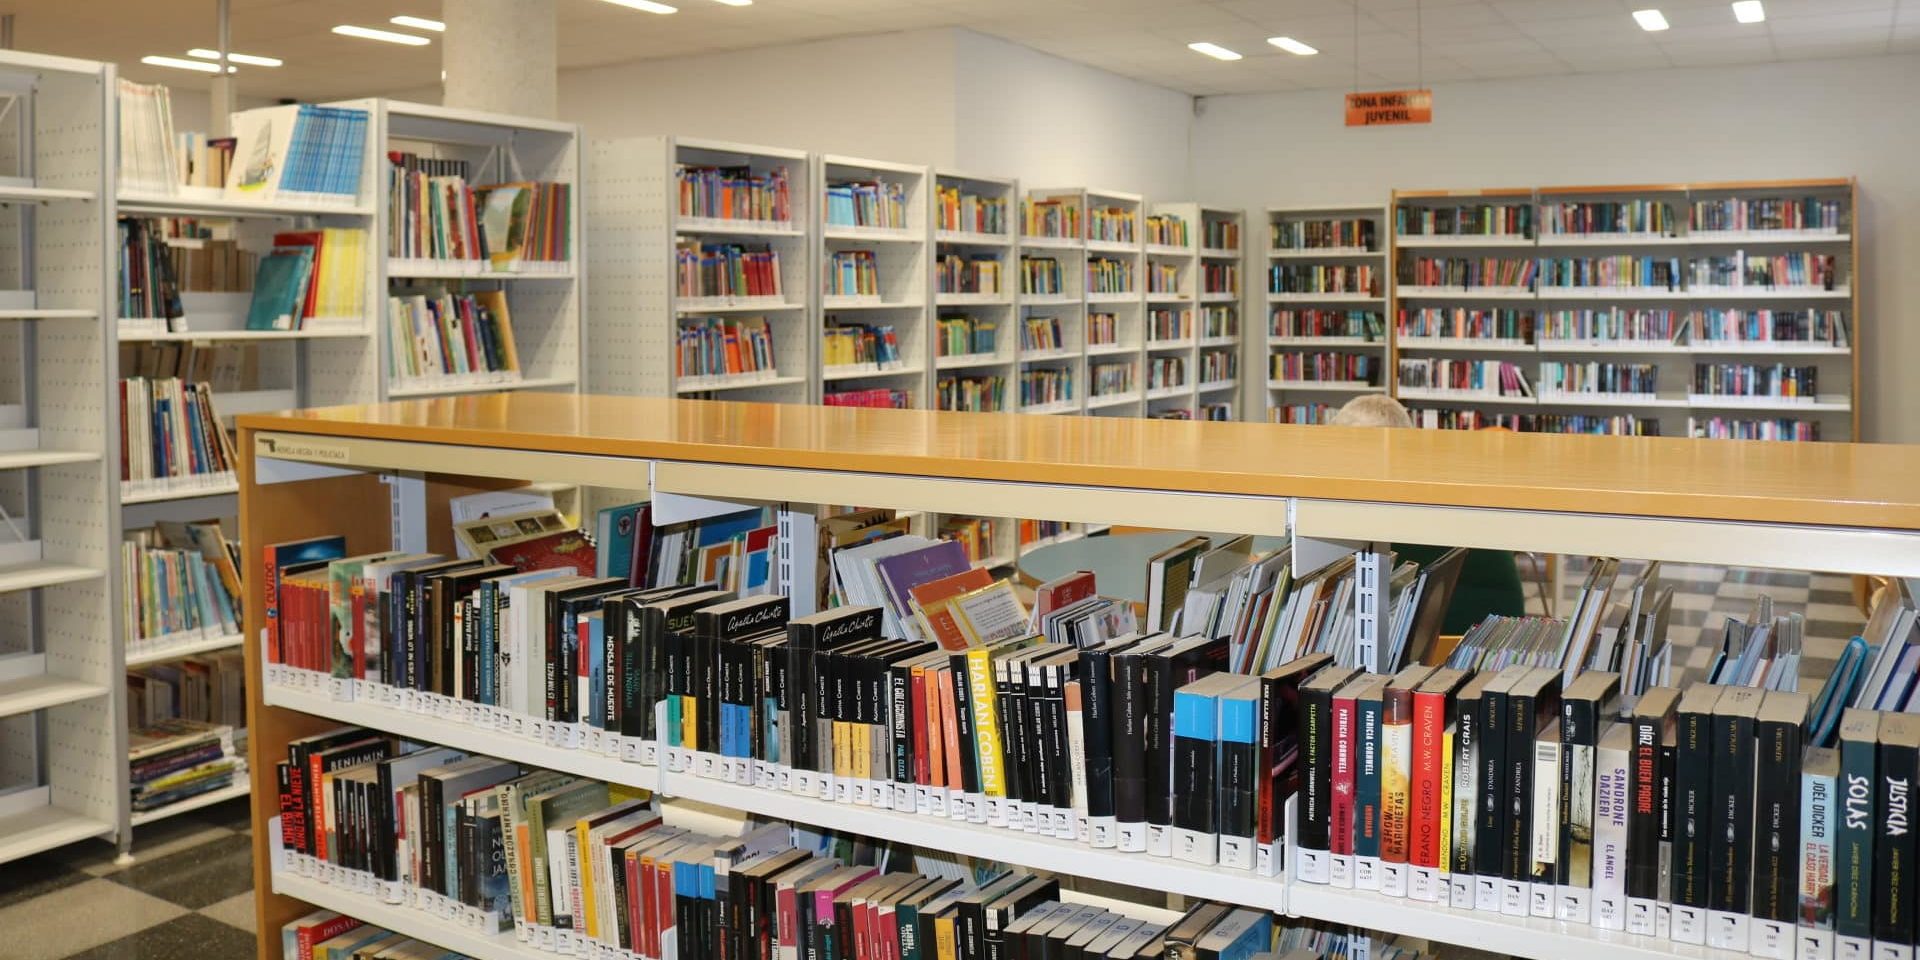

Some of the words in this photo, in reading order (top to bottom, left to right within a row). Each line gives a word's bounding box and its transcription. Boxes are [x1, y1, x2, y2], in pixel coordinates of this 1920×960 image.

[1365, 109, 1411, 125] JUVENIL
[728, 610, 754, 632] Agatha
[755, 605, 782, 624] Christie
[823, 621, 848, 642] Agatha
[849, 615, 874, 634] Christie
[606, 636, 615, 673] MENSAJE
[606, 675, 615, 686] DE
[970, 658, 990, 727] HARLAN
[606, 688, 615, 721] MUERTE
[1339, 709, 1348, 738] PATRICIA
[1365, 711, 1374, 740] PATRICIA
[1422, 705, 1432, 746] CRAVEN
[1462, 714, 1471, 745] CRAIS
[1639, 725, 1656, 745] DÍAZ
[330, 750, 385, 770] BENJAMIN
[978, 731, 996, 788] COBEN
[1339, 740, 1348, 773] CORNWELL
[1365, 742, 1374, 775] CORNWELL
[1422, 748, 1432, 771] M.W.
[1638, 747, 1653, 757] EL
[1461, 748, 1470, 787] ROBERT
[1638, 759, 1653, 782] BUEN
[312, 764, 320, 804] BENJAMIN
[1599, 775, 1610, 817] DAZIERI
[1613, 768, 1625, 827] SANDRONE
[1812, 780, 1828, 802] JOËL
[280, 794, 291, 809] EL
[1420, 779, 1432, 820] NEGRO
[1638, 784, 1652, 814] PADRE
[1845, 773, 1869, 831] SOLAS
[1886, 776, 1908, 837] JUSTICIA
[1384, 811, 1394, 844] SHOW
[1394, 791, 1404, 855] MARIONETAS
[1772, 803, 1780, 829] DICKER
[1811, 804, 1825, 838] DICKER
[1606, 844, 1615, 853] EL
[1806, 842, 1816, 850] EL
[1819, 844, 1829, 853] LA
[1806, 852, 1816, 871] CASO
[1818, 855, 1828, 883] VERDAD
[1806, 873, 1816, 895] HARRY
